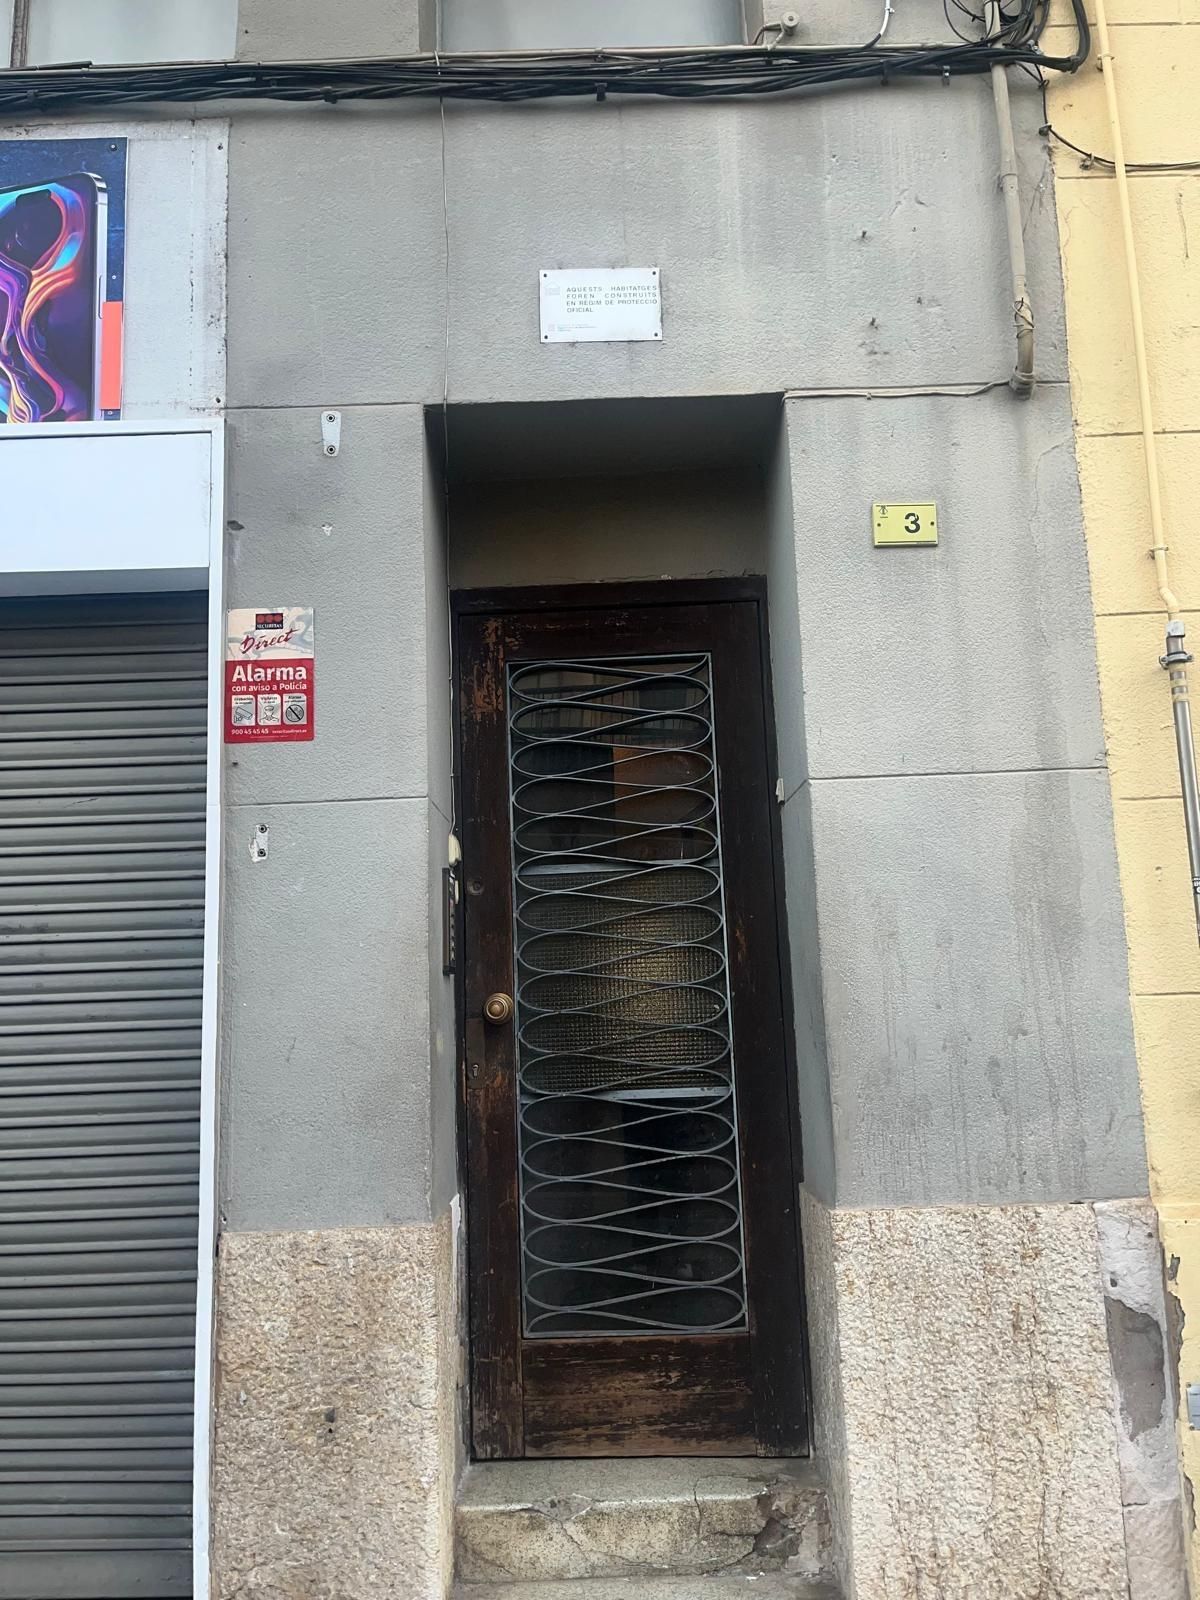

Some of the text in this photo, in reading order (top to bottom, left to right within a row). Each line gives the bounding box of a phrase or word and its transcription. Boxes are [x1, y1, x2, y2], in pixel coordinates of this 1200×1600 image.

[904, 512, 921, 534] 3
[241, 628, 298, 654] Direct
[232, 664, 307, 682] Alarma
[248, 684, 271, 692] aviso
